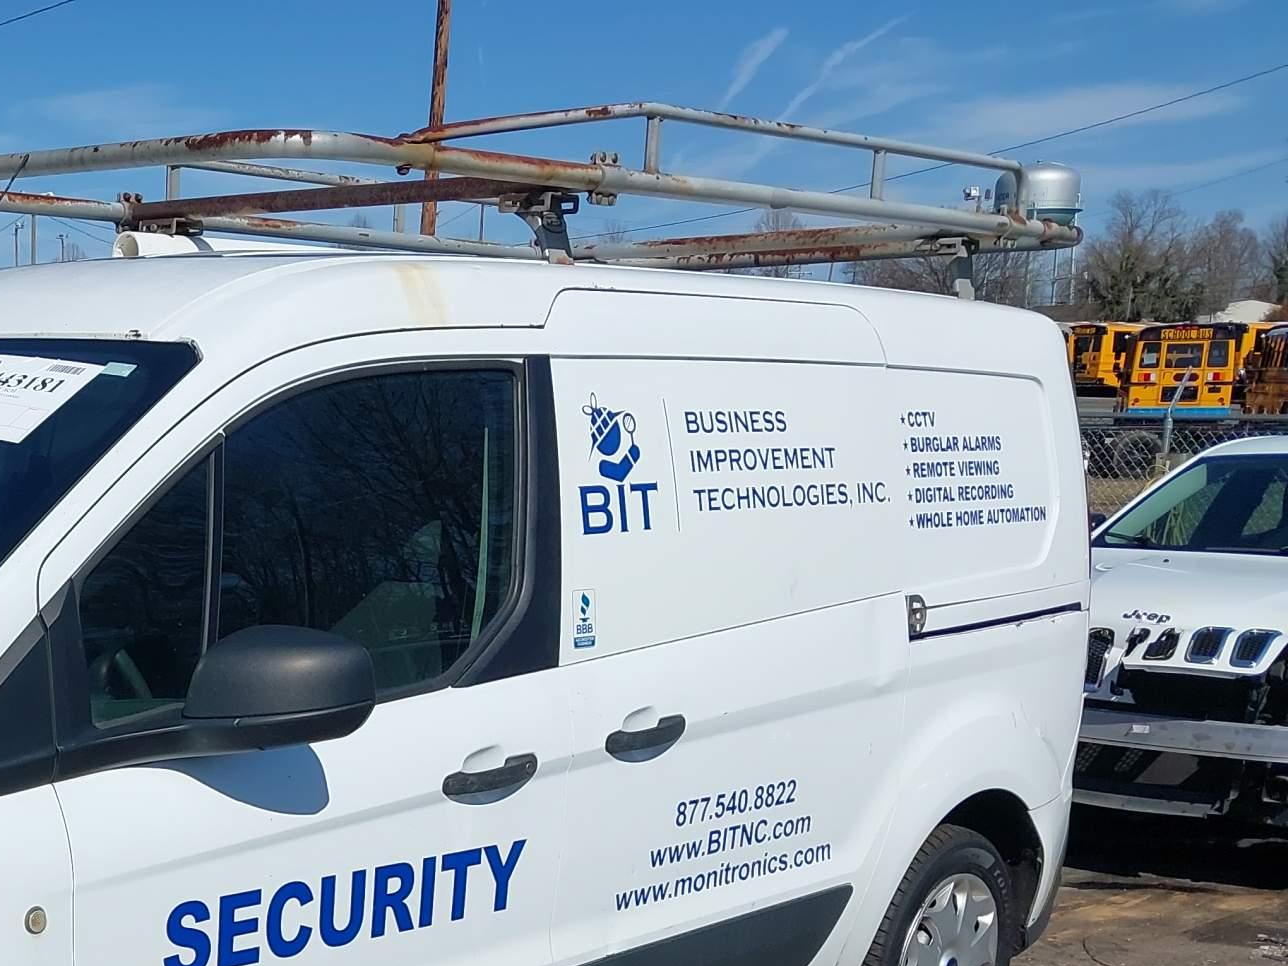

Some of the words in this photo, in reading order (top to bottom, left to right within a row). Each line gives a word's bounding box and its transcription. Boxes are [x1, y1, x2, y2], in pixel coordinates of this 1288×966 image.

[684, 410, 787, 434] BUSINESS
[907, 411, 935, 428] CCTV
[910, 436, 960, 452] BURGLAR
[962, 435, 1001, 451] ALARMS
[690, 447, 836, 472] IMPROVEMENT
[913, 461, 956, 478] REMOTE
[958, 460, 1000, 476] VIEWING
[693, 483, 853, 511] TECHNOLOGIES,
[857, 482, 891, 504] INC.
[915, 486, 955, 503] DIGITAL
[958, 484, 1014, 501] RECORDING
[578, 481, 658, 535] BIT
[916, 511, 953, 528] WHOLE
[956, 510, 984, 526] HOME
[987, 506, 1047, 524] AUTOMATION
[576, 623, 593, 635] BBB
[675, 779, 797, 827] 877.540.8822
[650, 815, 811, 868] www.BITNC.com
[615, 843, 831, 911] www.monitronics.com
